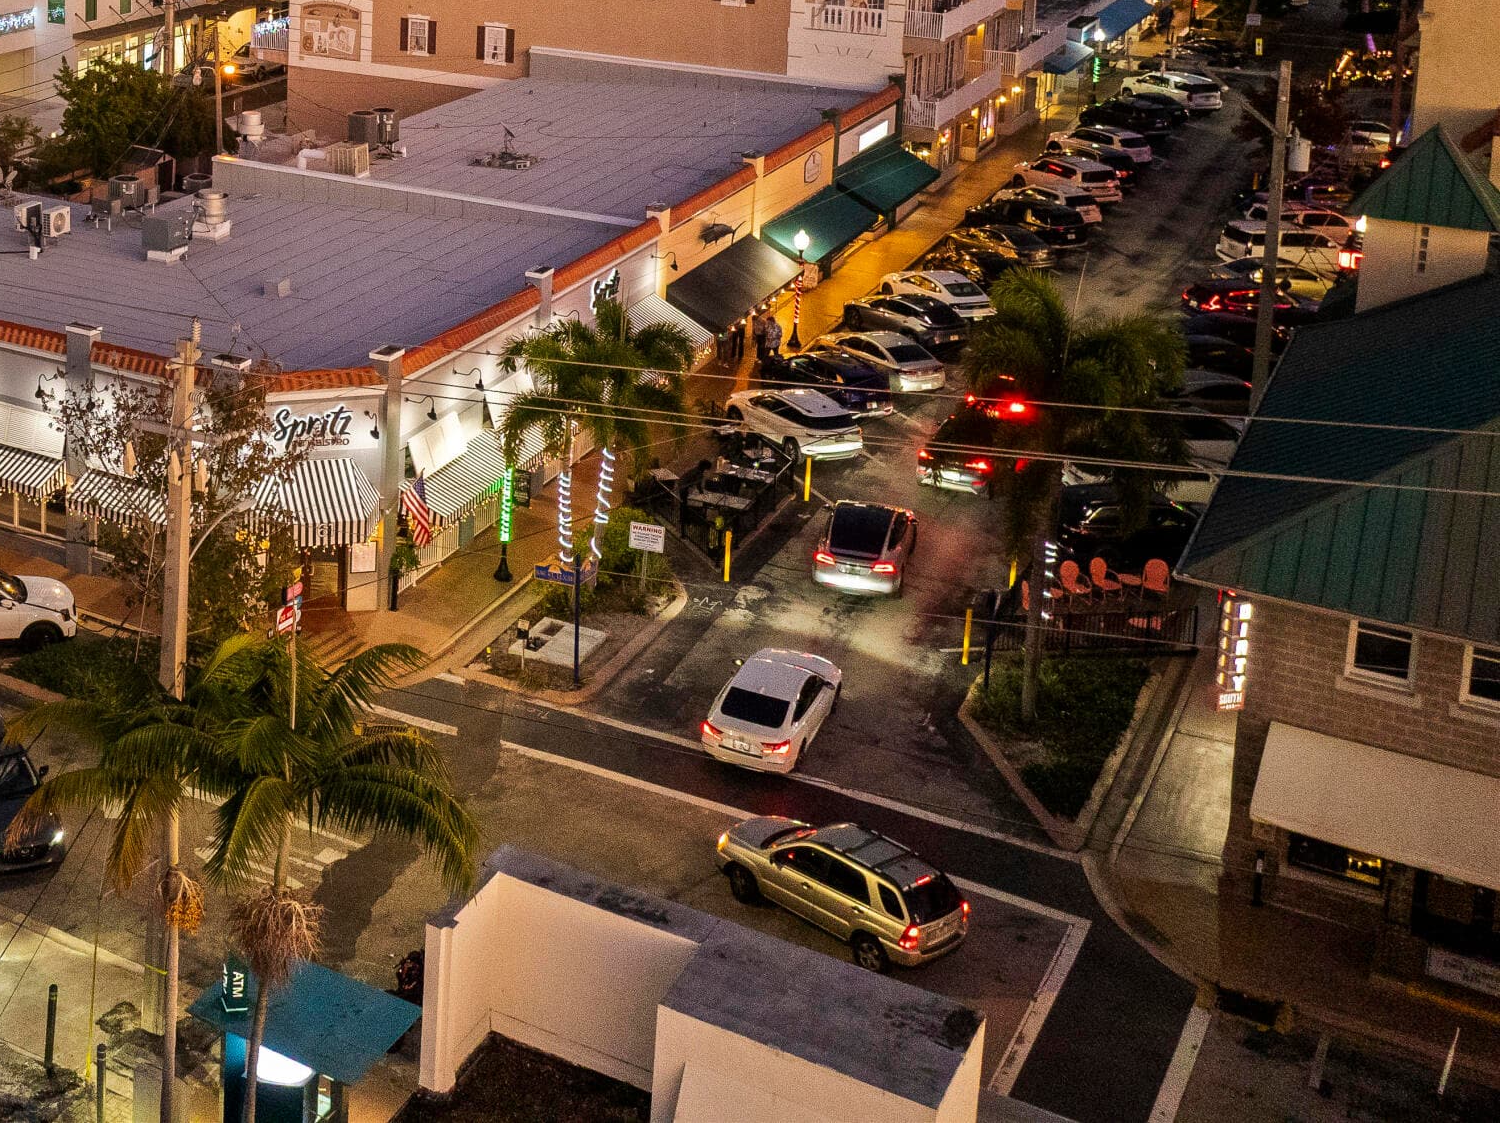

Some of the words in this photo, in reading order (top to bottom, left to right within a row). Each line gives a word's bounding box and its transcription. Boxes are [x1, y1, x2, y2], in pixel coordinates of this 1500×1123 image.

[274, 405, 353, 451] Spritz
[632, 524, 663, 534] WARNING
[232, 971, 244, 997] ATM
